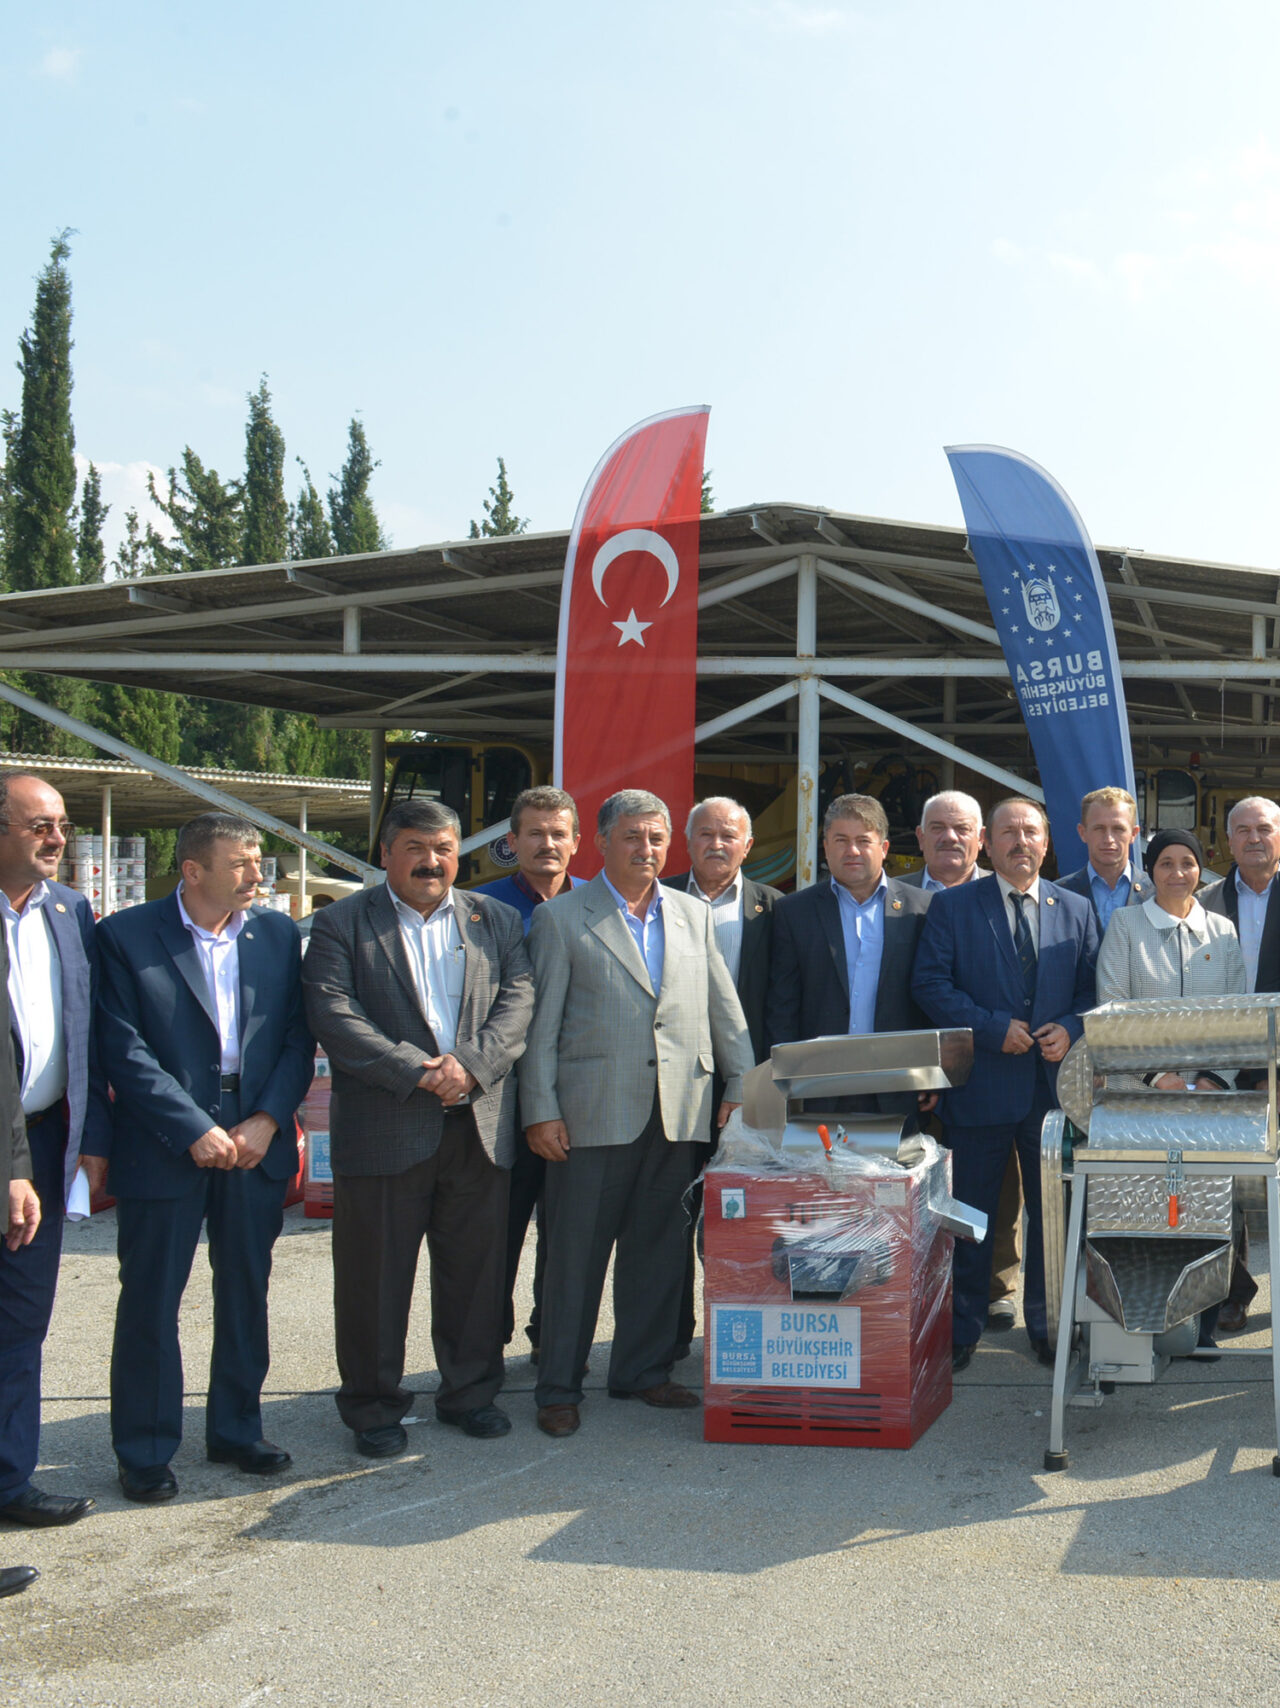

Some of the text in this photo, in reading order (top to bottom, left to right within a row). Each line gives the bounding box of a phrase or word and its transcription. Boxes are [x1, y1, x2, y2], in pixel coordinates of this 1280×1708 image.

[780, 1313, 839, 1334] BURSA
[722, 1352, 757, 1361] BURSA
[766, 1336, 853, 1359] BÜYÜKŞEHİR
[771, 1360, 848, 1380] BELEDİYESİ
